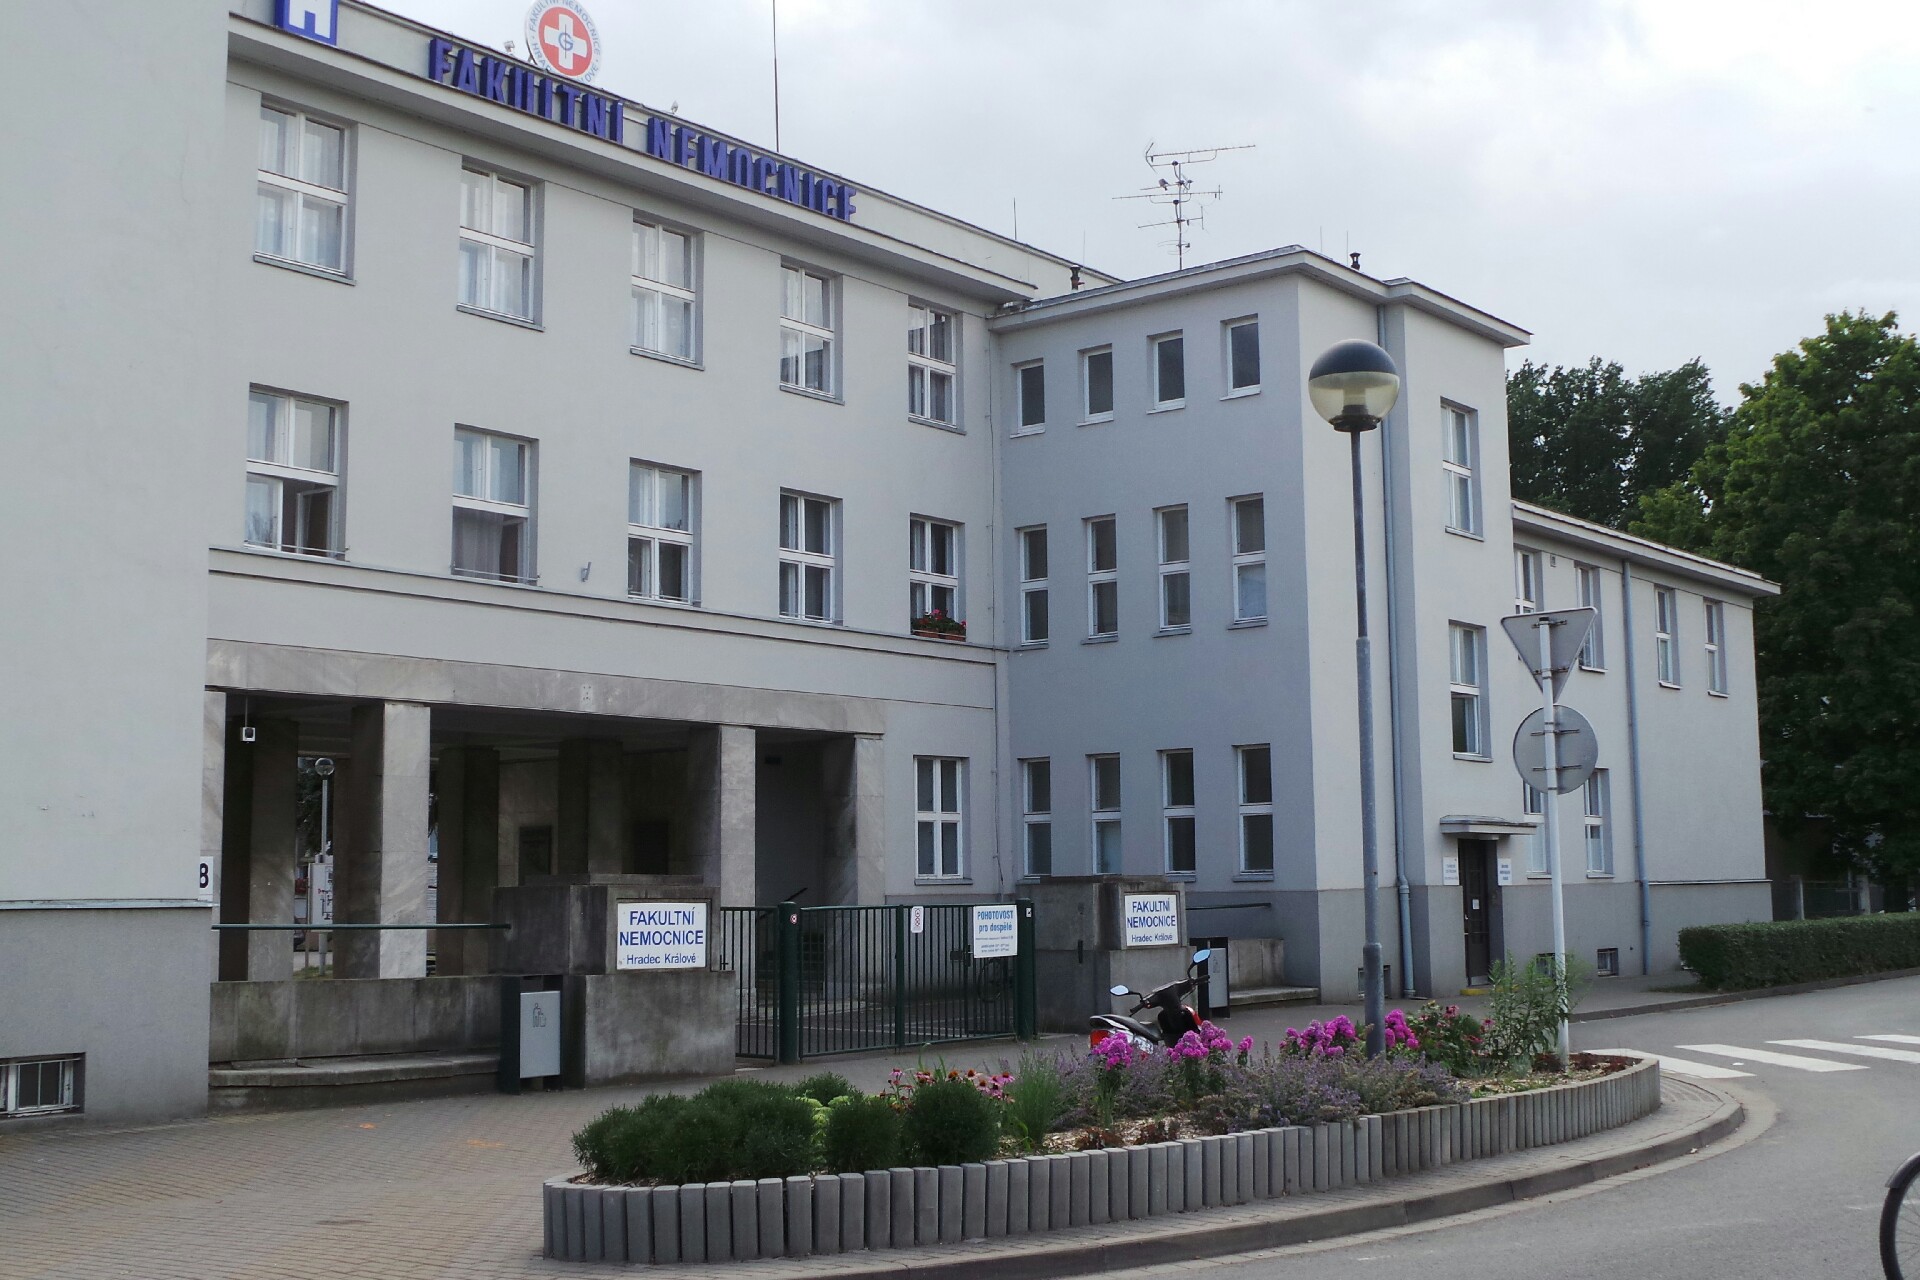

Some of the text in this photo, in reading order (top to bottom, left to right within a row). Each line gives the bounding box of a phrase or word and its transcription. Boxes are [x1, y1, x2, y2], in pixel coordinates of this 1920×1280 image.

[648, 116, 857, 221] NEMOCNICE
[1132, 897, 1170, 913] FAKULTNÍ
[629, 906, 696, 926] FAKULTNÍ
[977, 910, 1014, 921] POHOTOVOST
[1127, 915, 1176, 929] NEMOCNICE
[978, 924, 989, 934] pro
[619, 930, 704, 946] NEMOCNICE
[1131, 934, 1153, 943] Hradec
[626, 952, 697, 965] Hradec Králové
